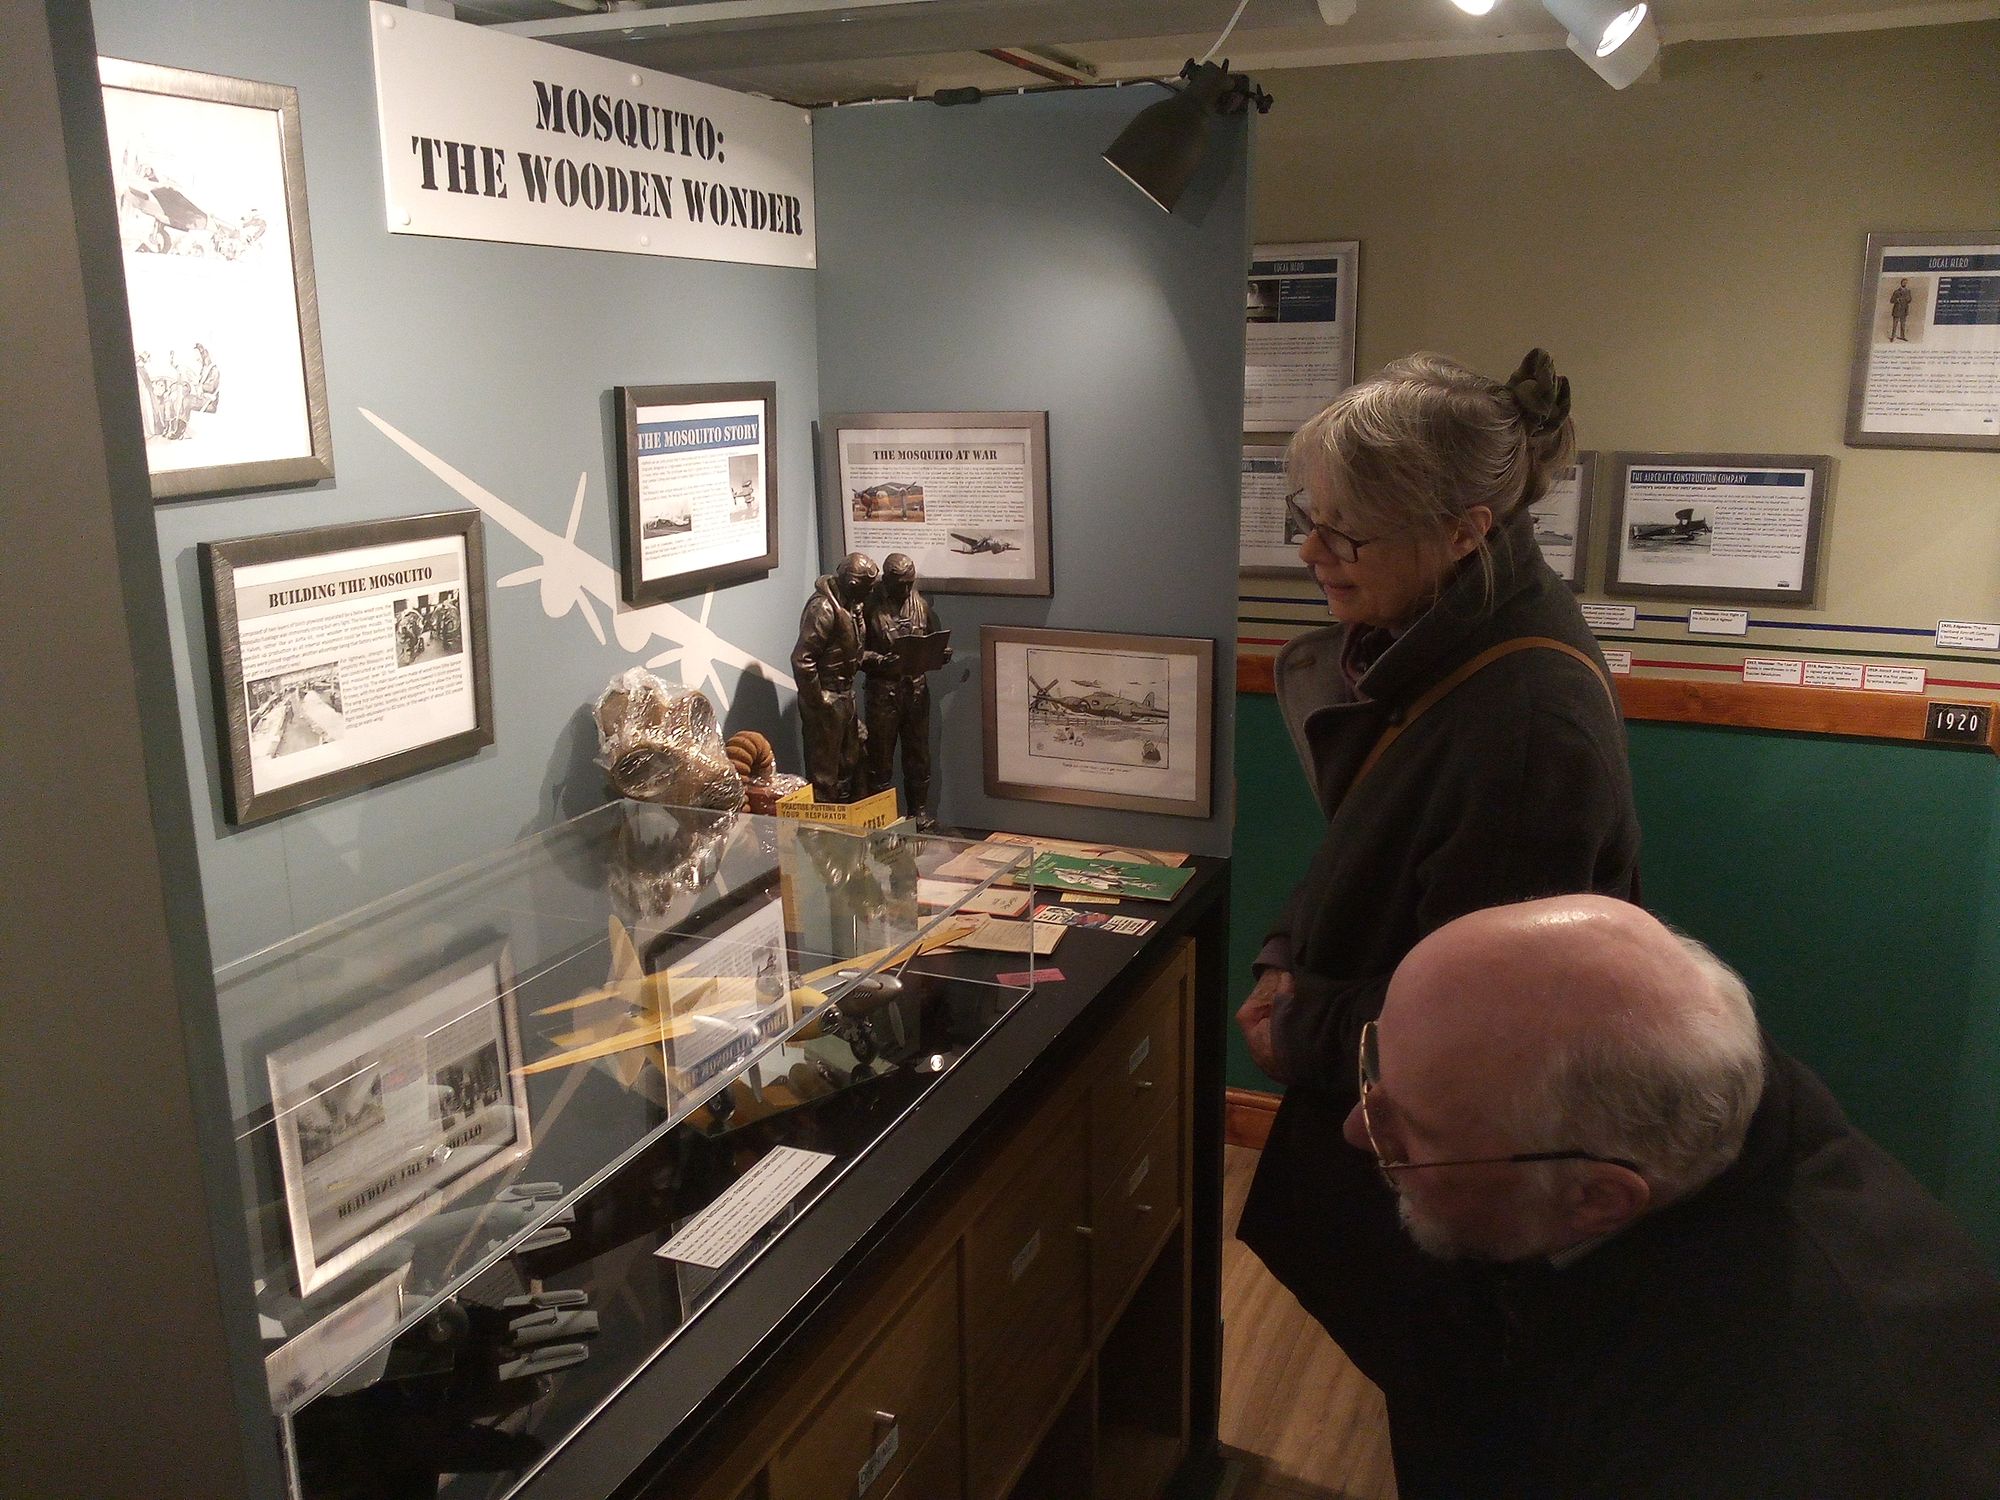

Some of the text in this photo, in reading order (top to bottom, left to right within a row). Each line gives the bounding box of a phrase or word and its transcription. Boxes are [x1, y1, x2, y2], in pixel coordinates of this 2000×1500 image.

[532, 79, 726, 164] MOSQUITO:
[411, 135, 804, 236] THE WOODEN WONDER
[1928, 257, 1969, 269] LOCAL HERO
[637, 423, 759, 450] THE MOSQUITO STORY
[872, 450, 998, 461] THE MOSQUITO AT WAR
[1632, 472, 1748, 484] THE AIRCRAFT CONSTRUCTION COMPANY
[269, 566, 433, 609] BUILDING THE MOSQUITO
[1937, 712, 1978, 731] 1920
[804, 812, 847, 820] RESPIRATOR
